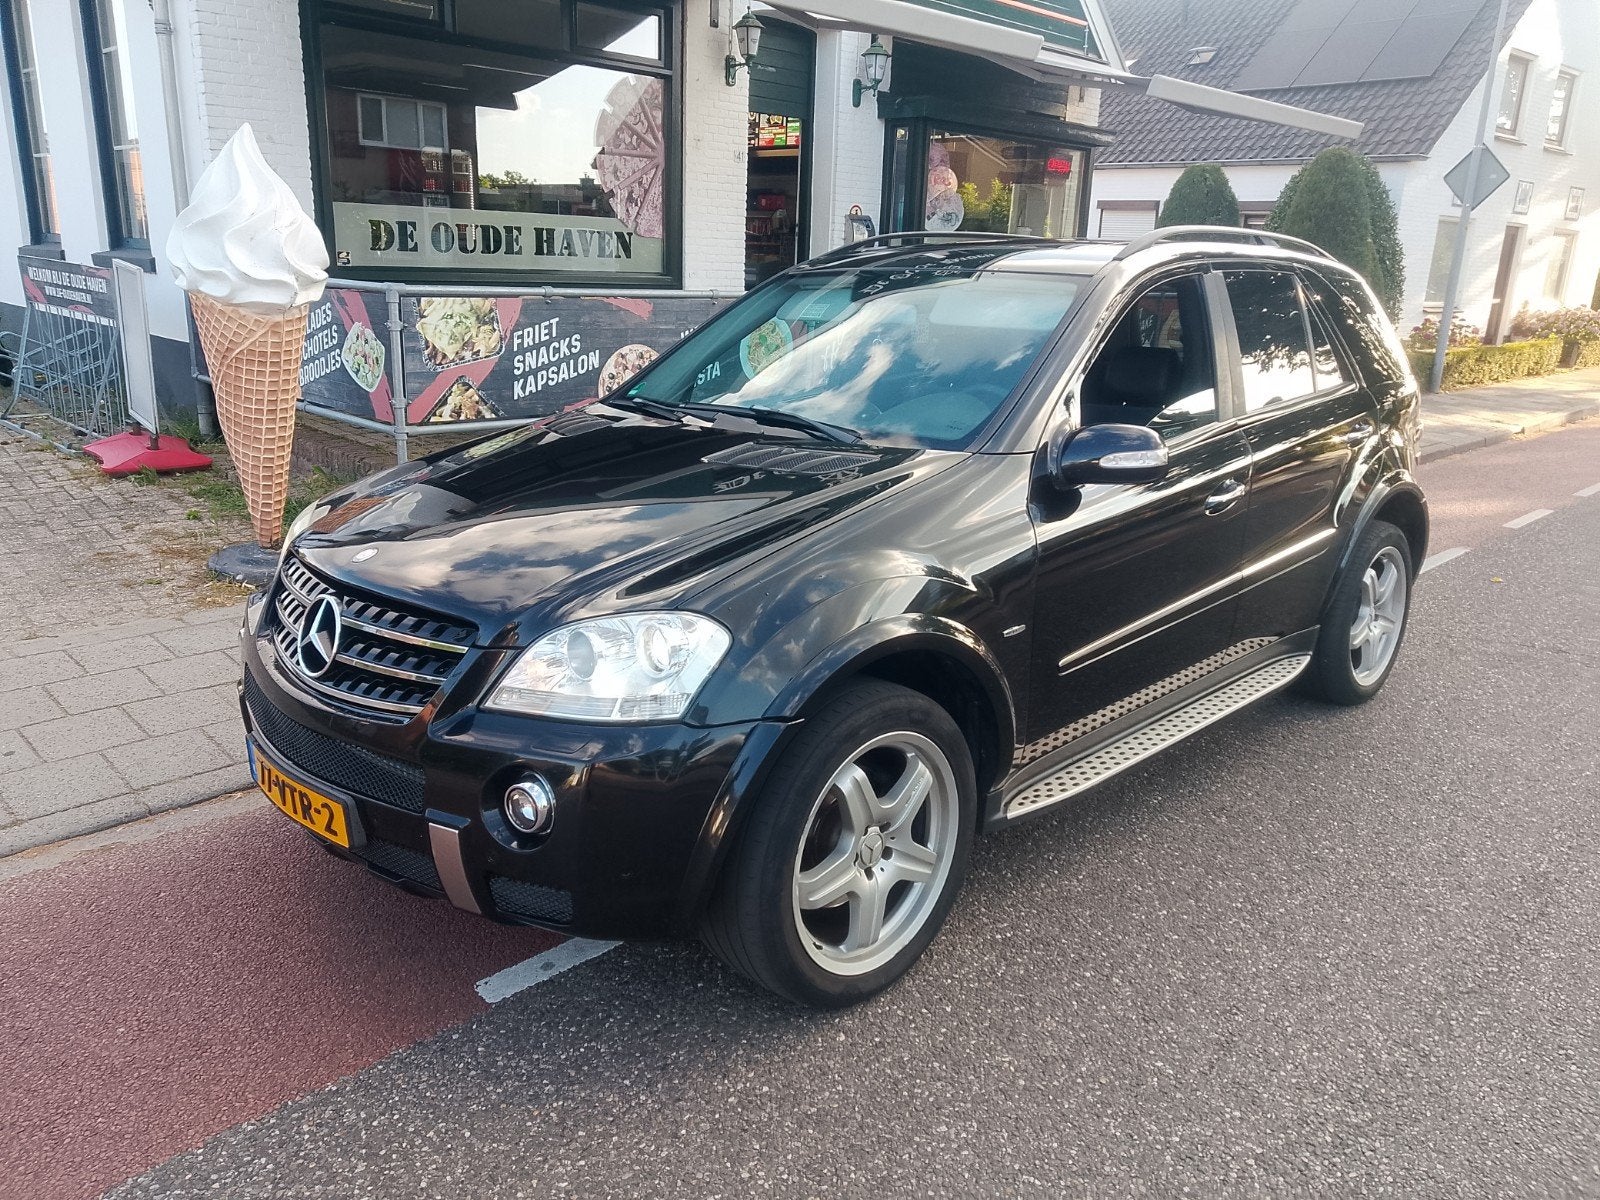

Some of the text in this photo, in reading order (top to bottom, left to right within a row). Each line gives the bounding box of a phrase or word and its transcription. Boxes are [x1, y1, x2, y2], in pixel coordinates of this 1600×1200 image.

[368, 219, 634, 259] DE OUDE HAVEN
[27, 266, 52, 282] WELKOM
[62, 271, 71, 287] DE
[70, 274, 87, 290] OUDE
[86, 276, 107, 293] HAVEN
[306, 302, 332, 334] LADES
[513, 317, 560, 351] FRIET
[301, 324, 338, 361] CHOTELS
[513, 333, 581, 376] SNACKS
[299, 348, 342, 387] BROODJES
[513, 350, 600, 400] KAPSALON
[693, 361, 721, 388] STA
